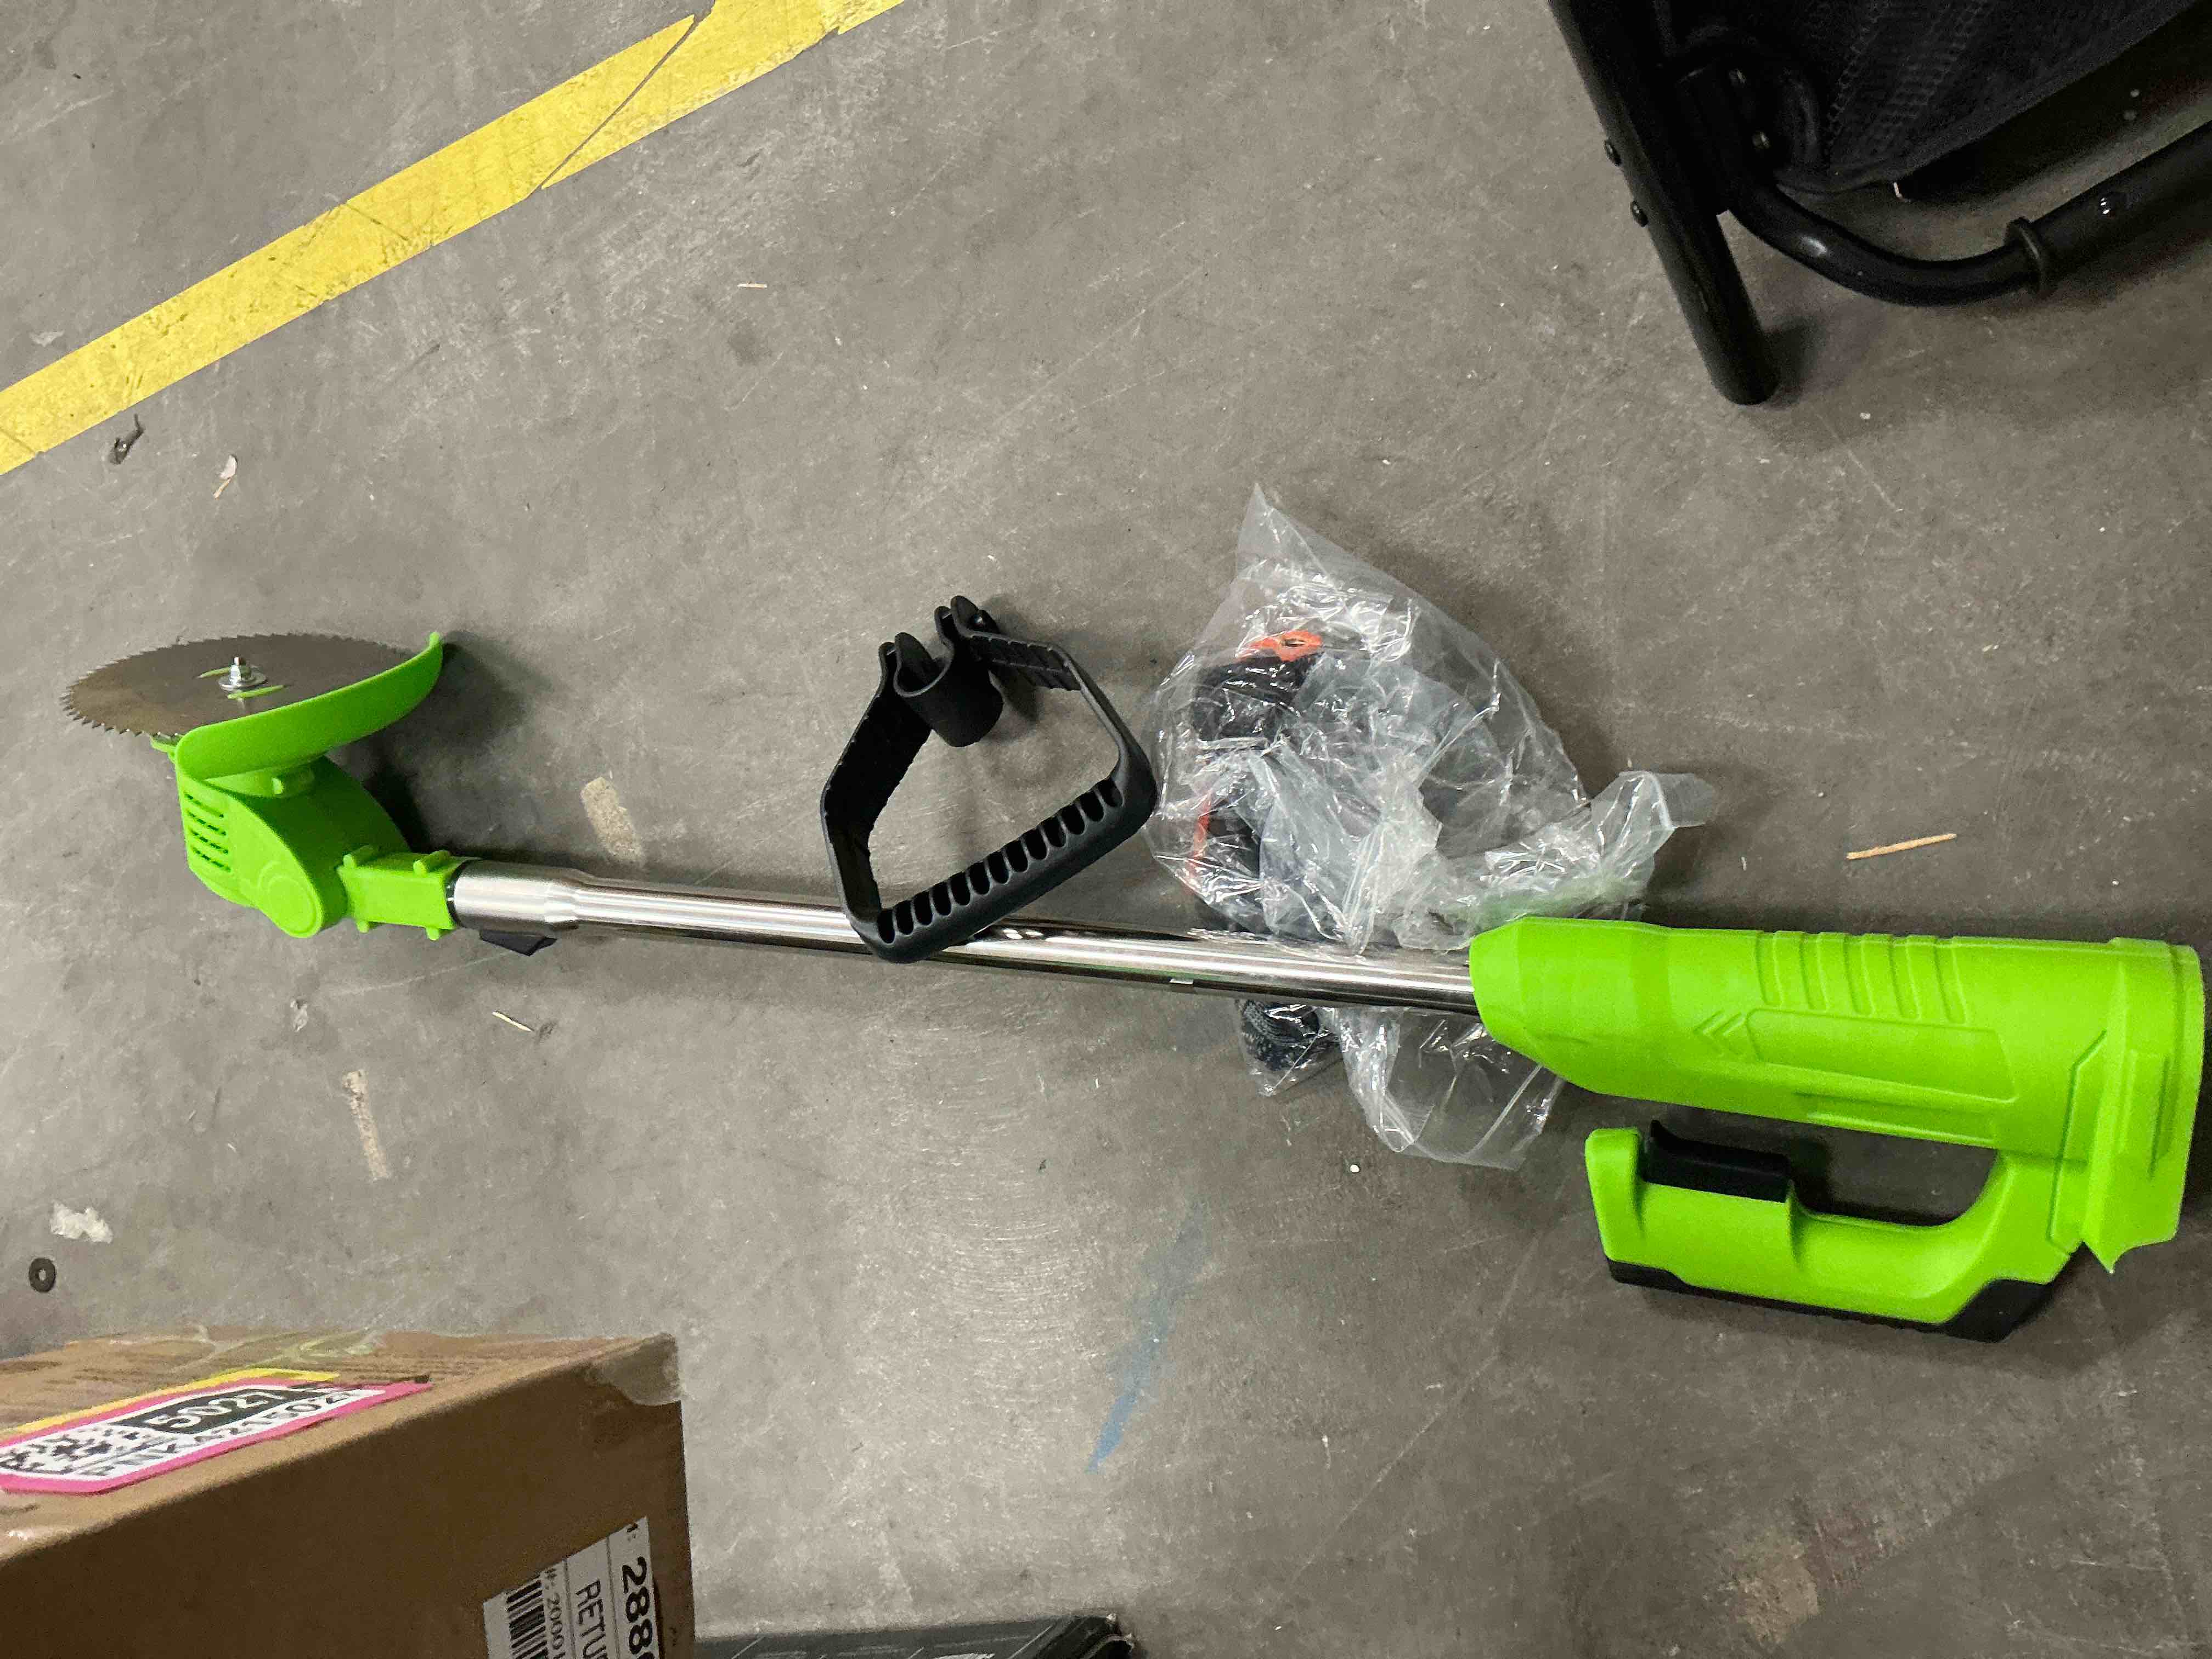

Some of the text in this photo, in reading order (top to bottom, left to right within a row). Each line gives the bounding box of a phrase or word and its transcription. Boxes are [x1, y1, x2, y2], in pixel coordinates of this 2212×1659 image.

[547, 1592, 566, 1659] 2000
[576, 1578, 607, 1659] RETU
[622, 1556, 655, 1659] 288
